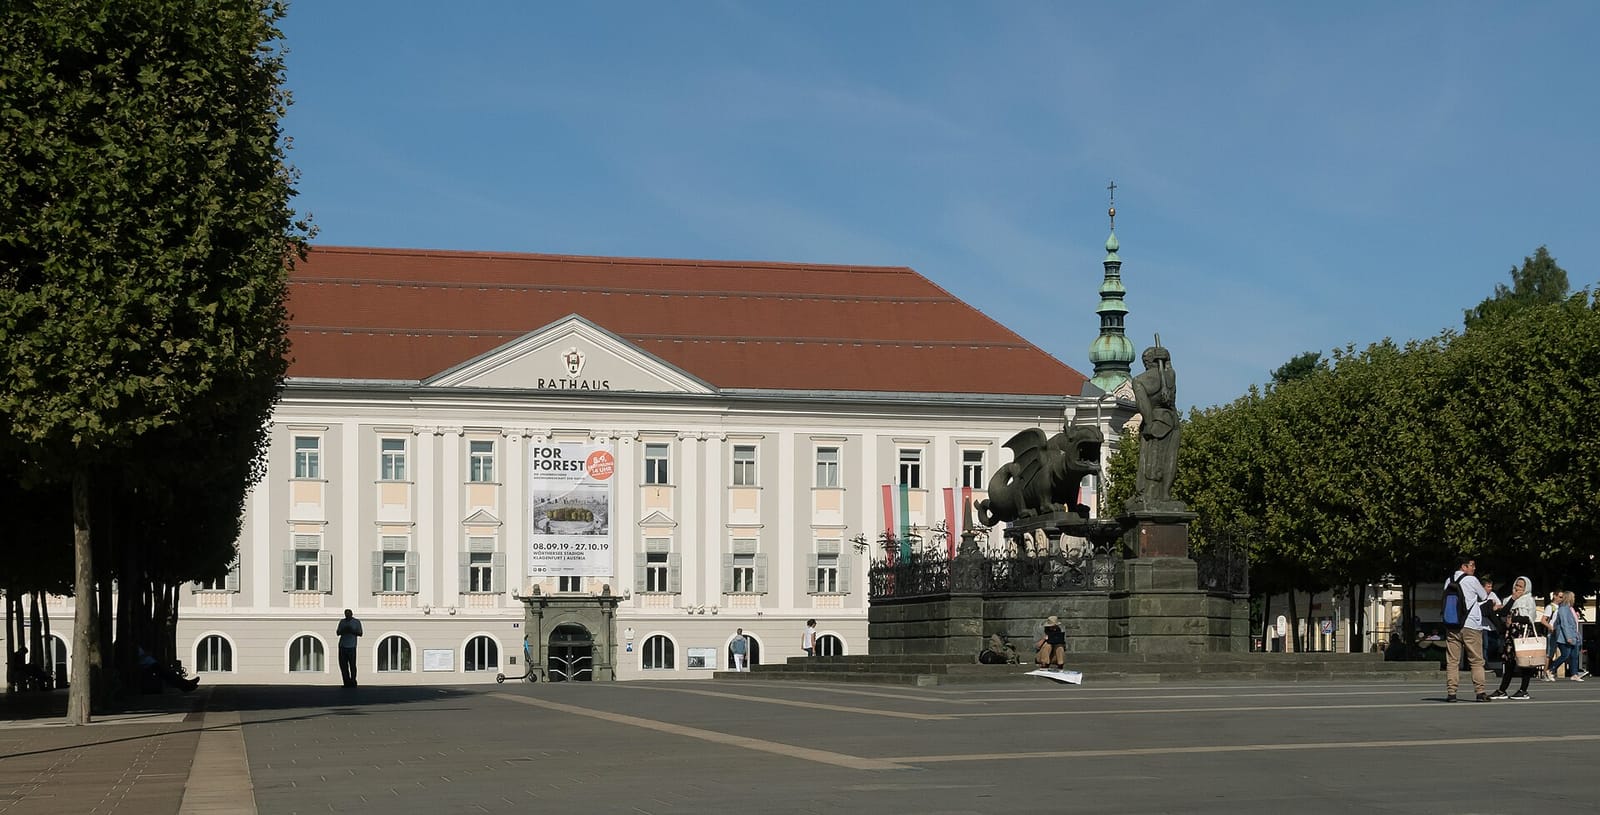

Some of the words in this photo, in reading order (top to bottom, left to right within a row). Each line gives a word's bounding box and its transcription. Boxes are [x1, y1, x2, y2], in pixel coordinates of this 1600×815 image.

[537, 378, 610, 390] RATHAUS
[533, 448, 562, 459] FOR
[533, 460, 585, 471] FOREST
[575, 543, 609, 551] 27.10.19
